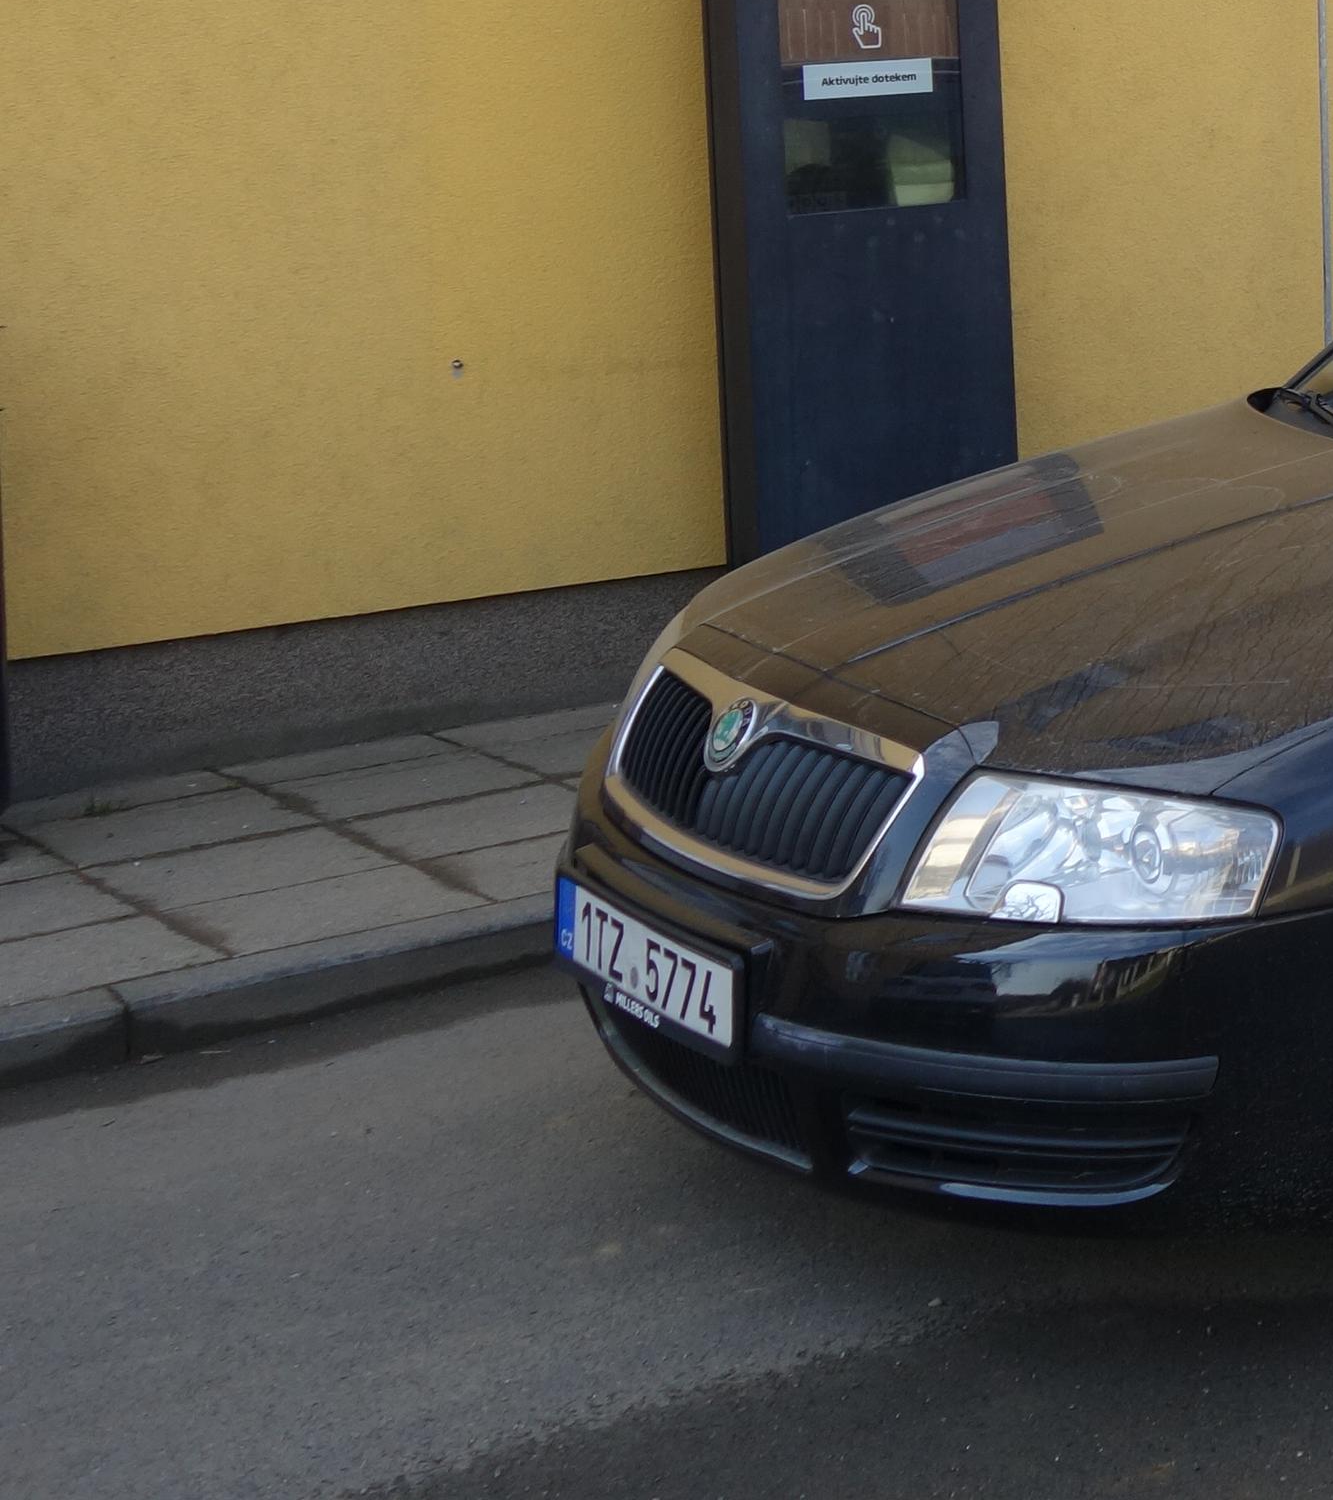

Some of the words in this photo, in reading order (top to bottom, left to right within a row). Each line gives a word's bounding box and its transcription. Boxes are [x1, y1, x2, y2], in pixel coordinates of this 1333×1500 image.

[821, 75, 869, 87] Aktivujte
[871, 72, 917, 84] dotekem
[561, 928, 573, 950] CZ
[582, 901, 624, 983] 1TZ
[645, 938, 717, 1035] 5774
